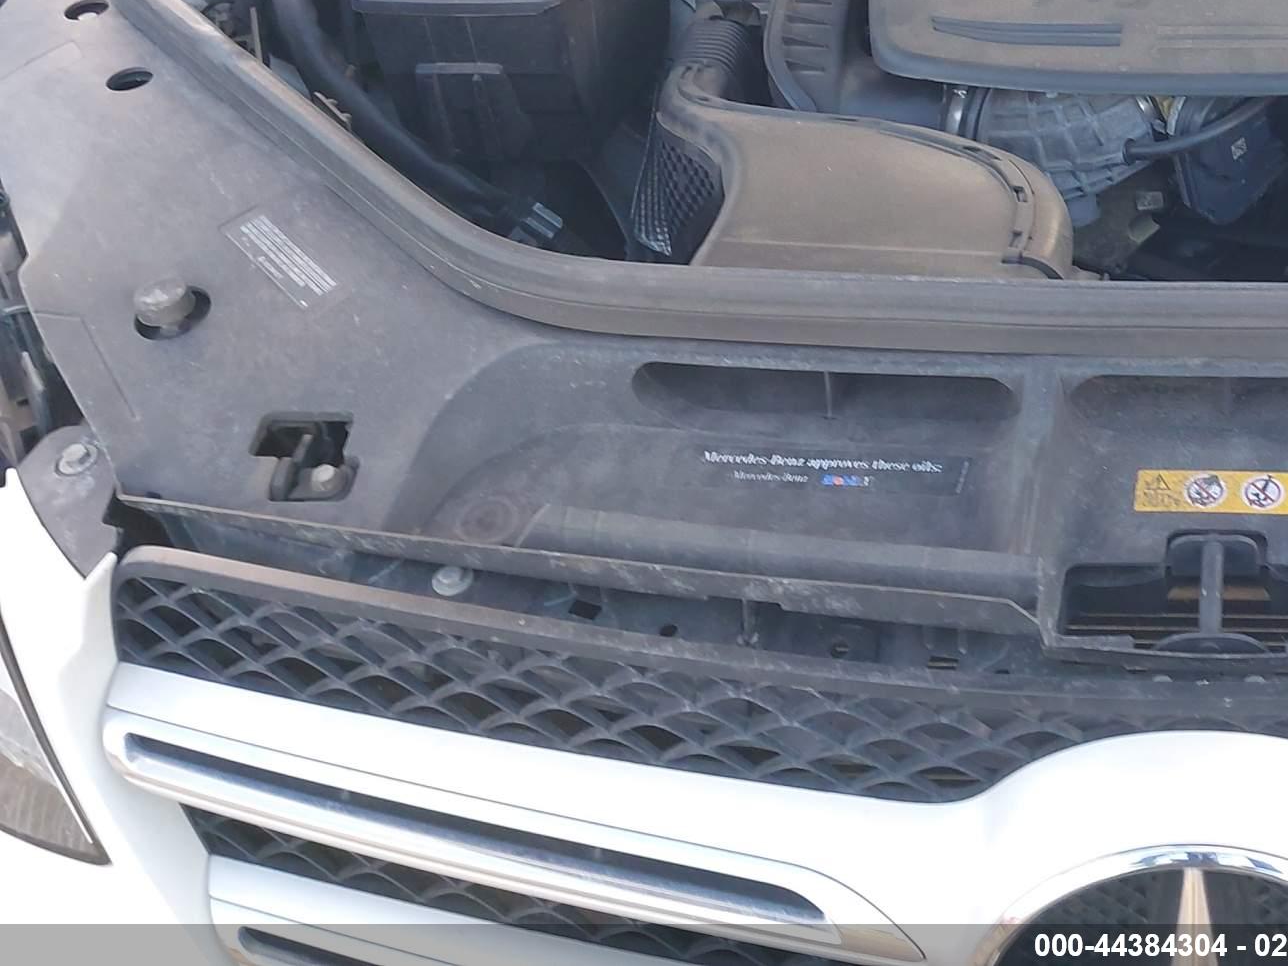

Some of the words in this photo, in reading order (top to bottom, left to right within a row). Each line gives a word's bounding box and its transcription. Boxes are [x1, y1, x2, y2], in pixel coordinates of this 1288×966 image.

[704, 451, 805, 467] Mercedes-Benz
[806, 458, 869, 471] approves
[871, 459, 910, 471] these
